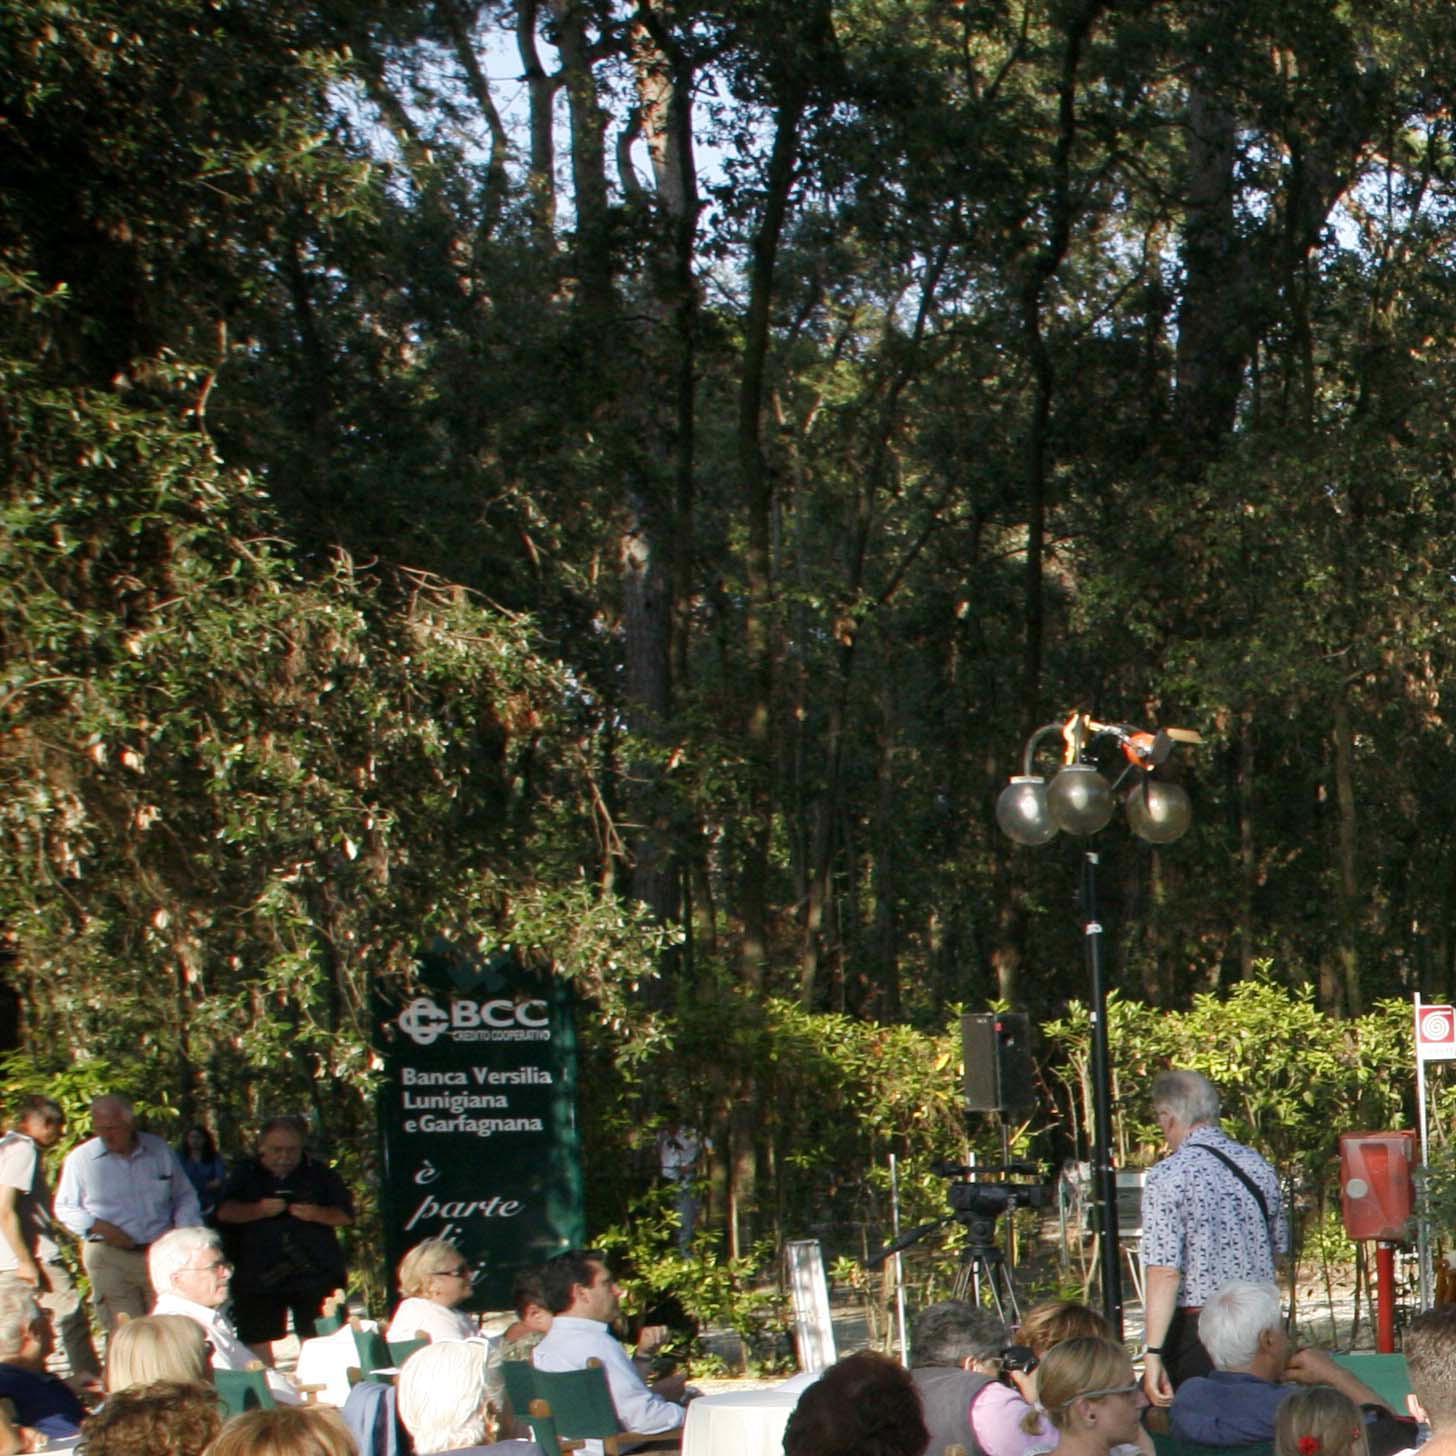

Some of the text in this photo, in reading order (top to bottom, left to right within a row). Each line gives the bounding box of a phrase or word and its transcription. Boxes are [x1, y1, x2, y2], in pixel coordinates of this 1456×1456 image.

[452, 1000, 549, 1028] BCC
[401, 1066, 552, 1086] Banca Versilia
[403, 1091, 508, 1113] Lunigiana
[404, 1114, 543, 1137] e Garfagnana
[414, 1160, 441, 1185] è
[403, 1195, 526, 1231] parte
